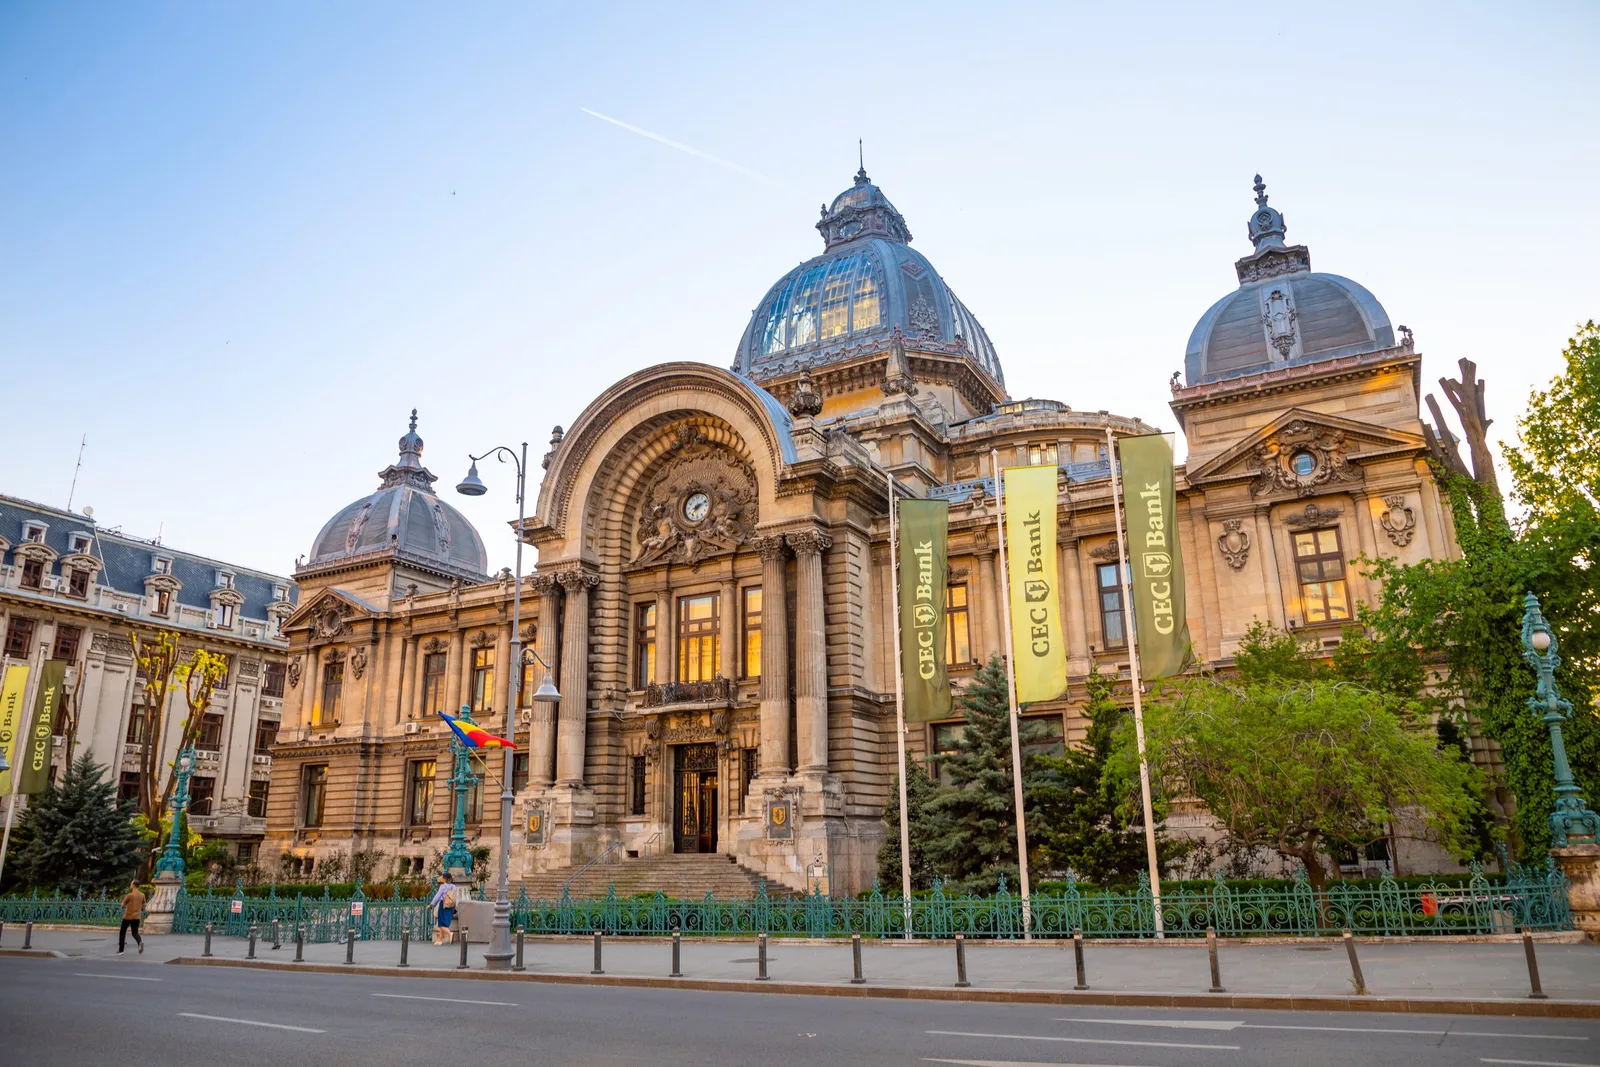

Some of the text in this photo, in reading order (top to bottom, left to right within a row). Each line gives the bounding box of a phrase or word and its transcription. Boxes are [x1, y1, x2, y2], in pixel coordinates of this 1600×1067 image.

[914, 540, 936, 680] CEC Bank
[1023, 510, 1051, 657] CEC Bank
[1140, 481, 1174, 635] CEC Bank
[3, 692, 17, 727] Bank
[32, 686, 55, 771] CEC Bank
